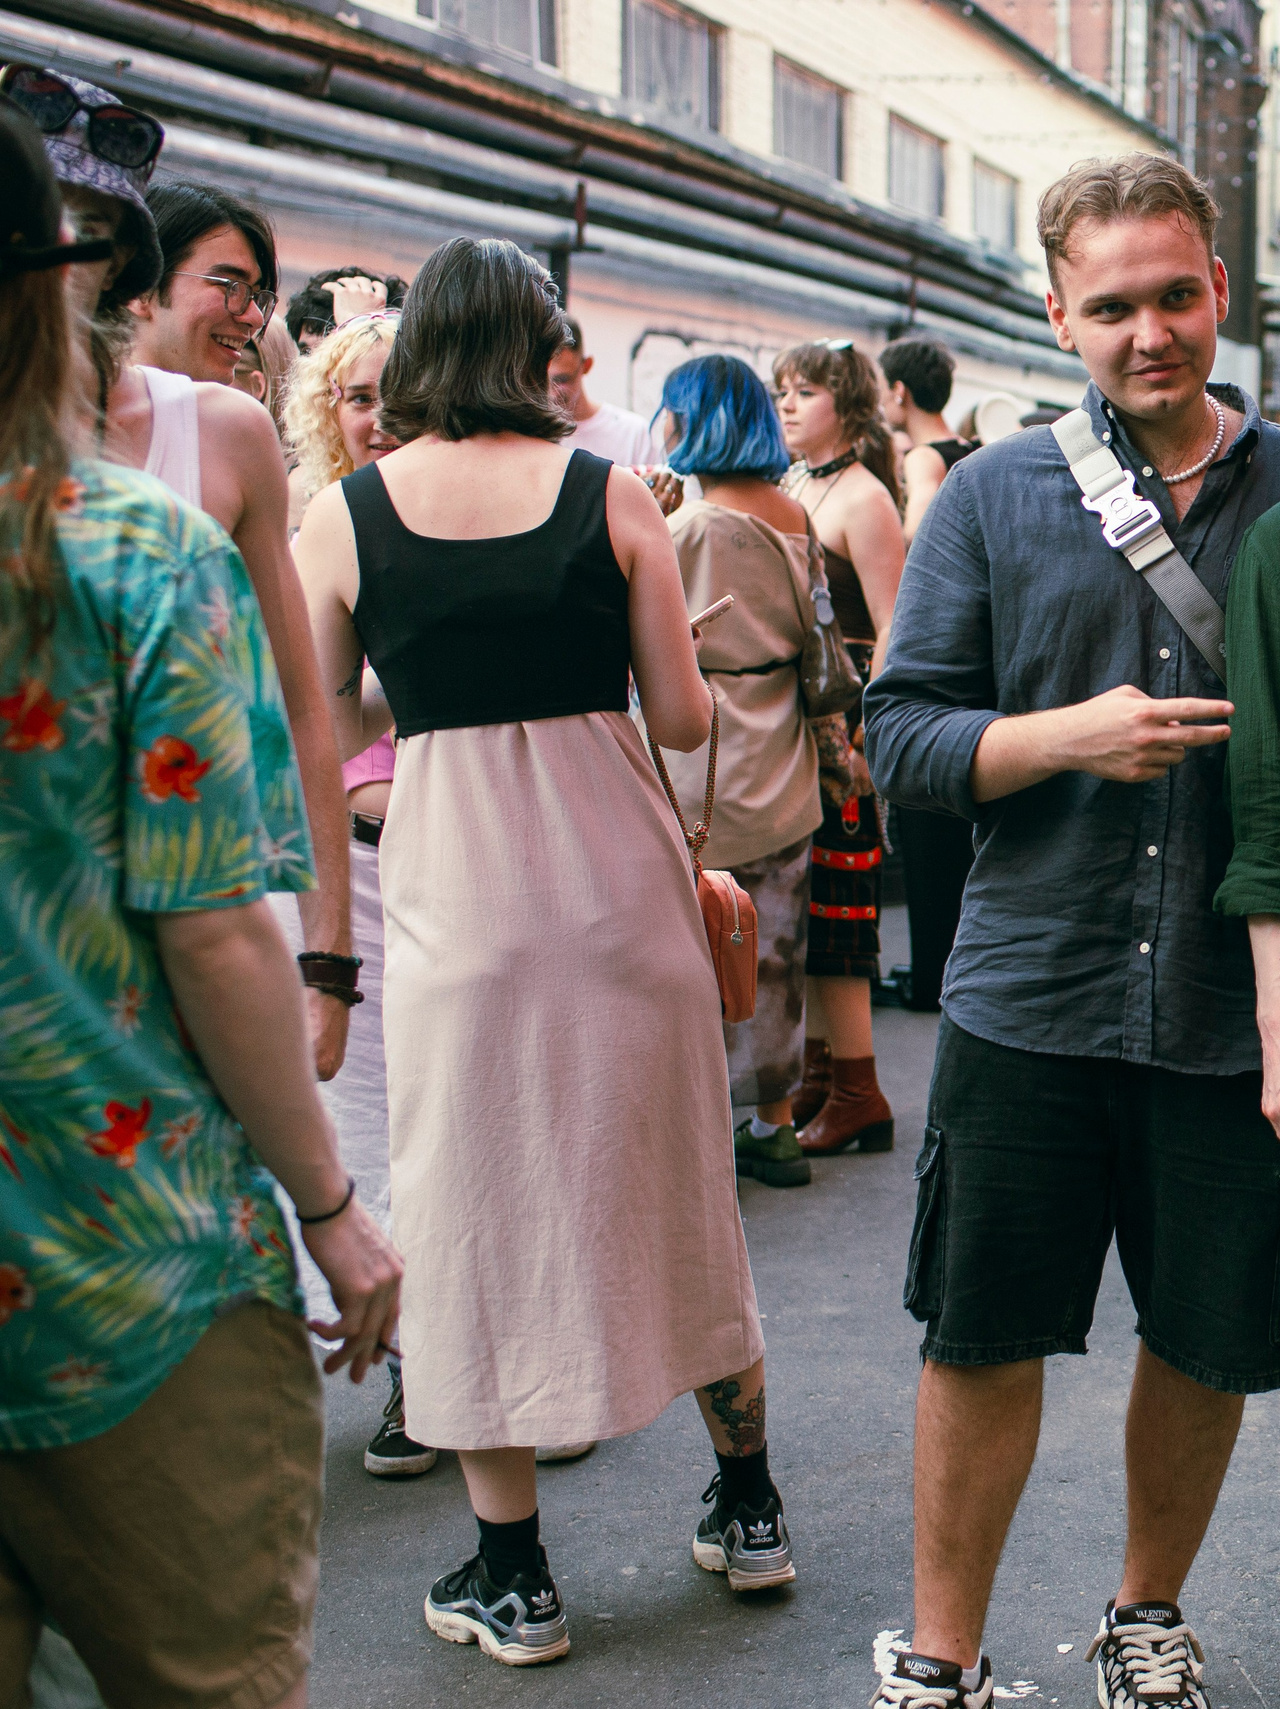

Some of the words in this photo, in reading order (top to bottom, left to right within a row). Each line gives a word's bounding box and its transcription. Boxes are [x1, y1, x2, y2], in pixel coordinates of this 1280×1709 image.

[749, 1536, 774, 1544] adidas
[534, 1604, 557, 1616] adidas
[1135, 1609, 1173, 1619] VALENTINO
[904, 1660, 941, 1677] VALENTINO
